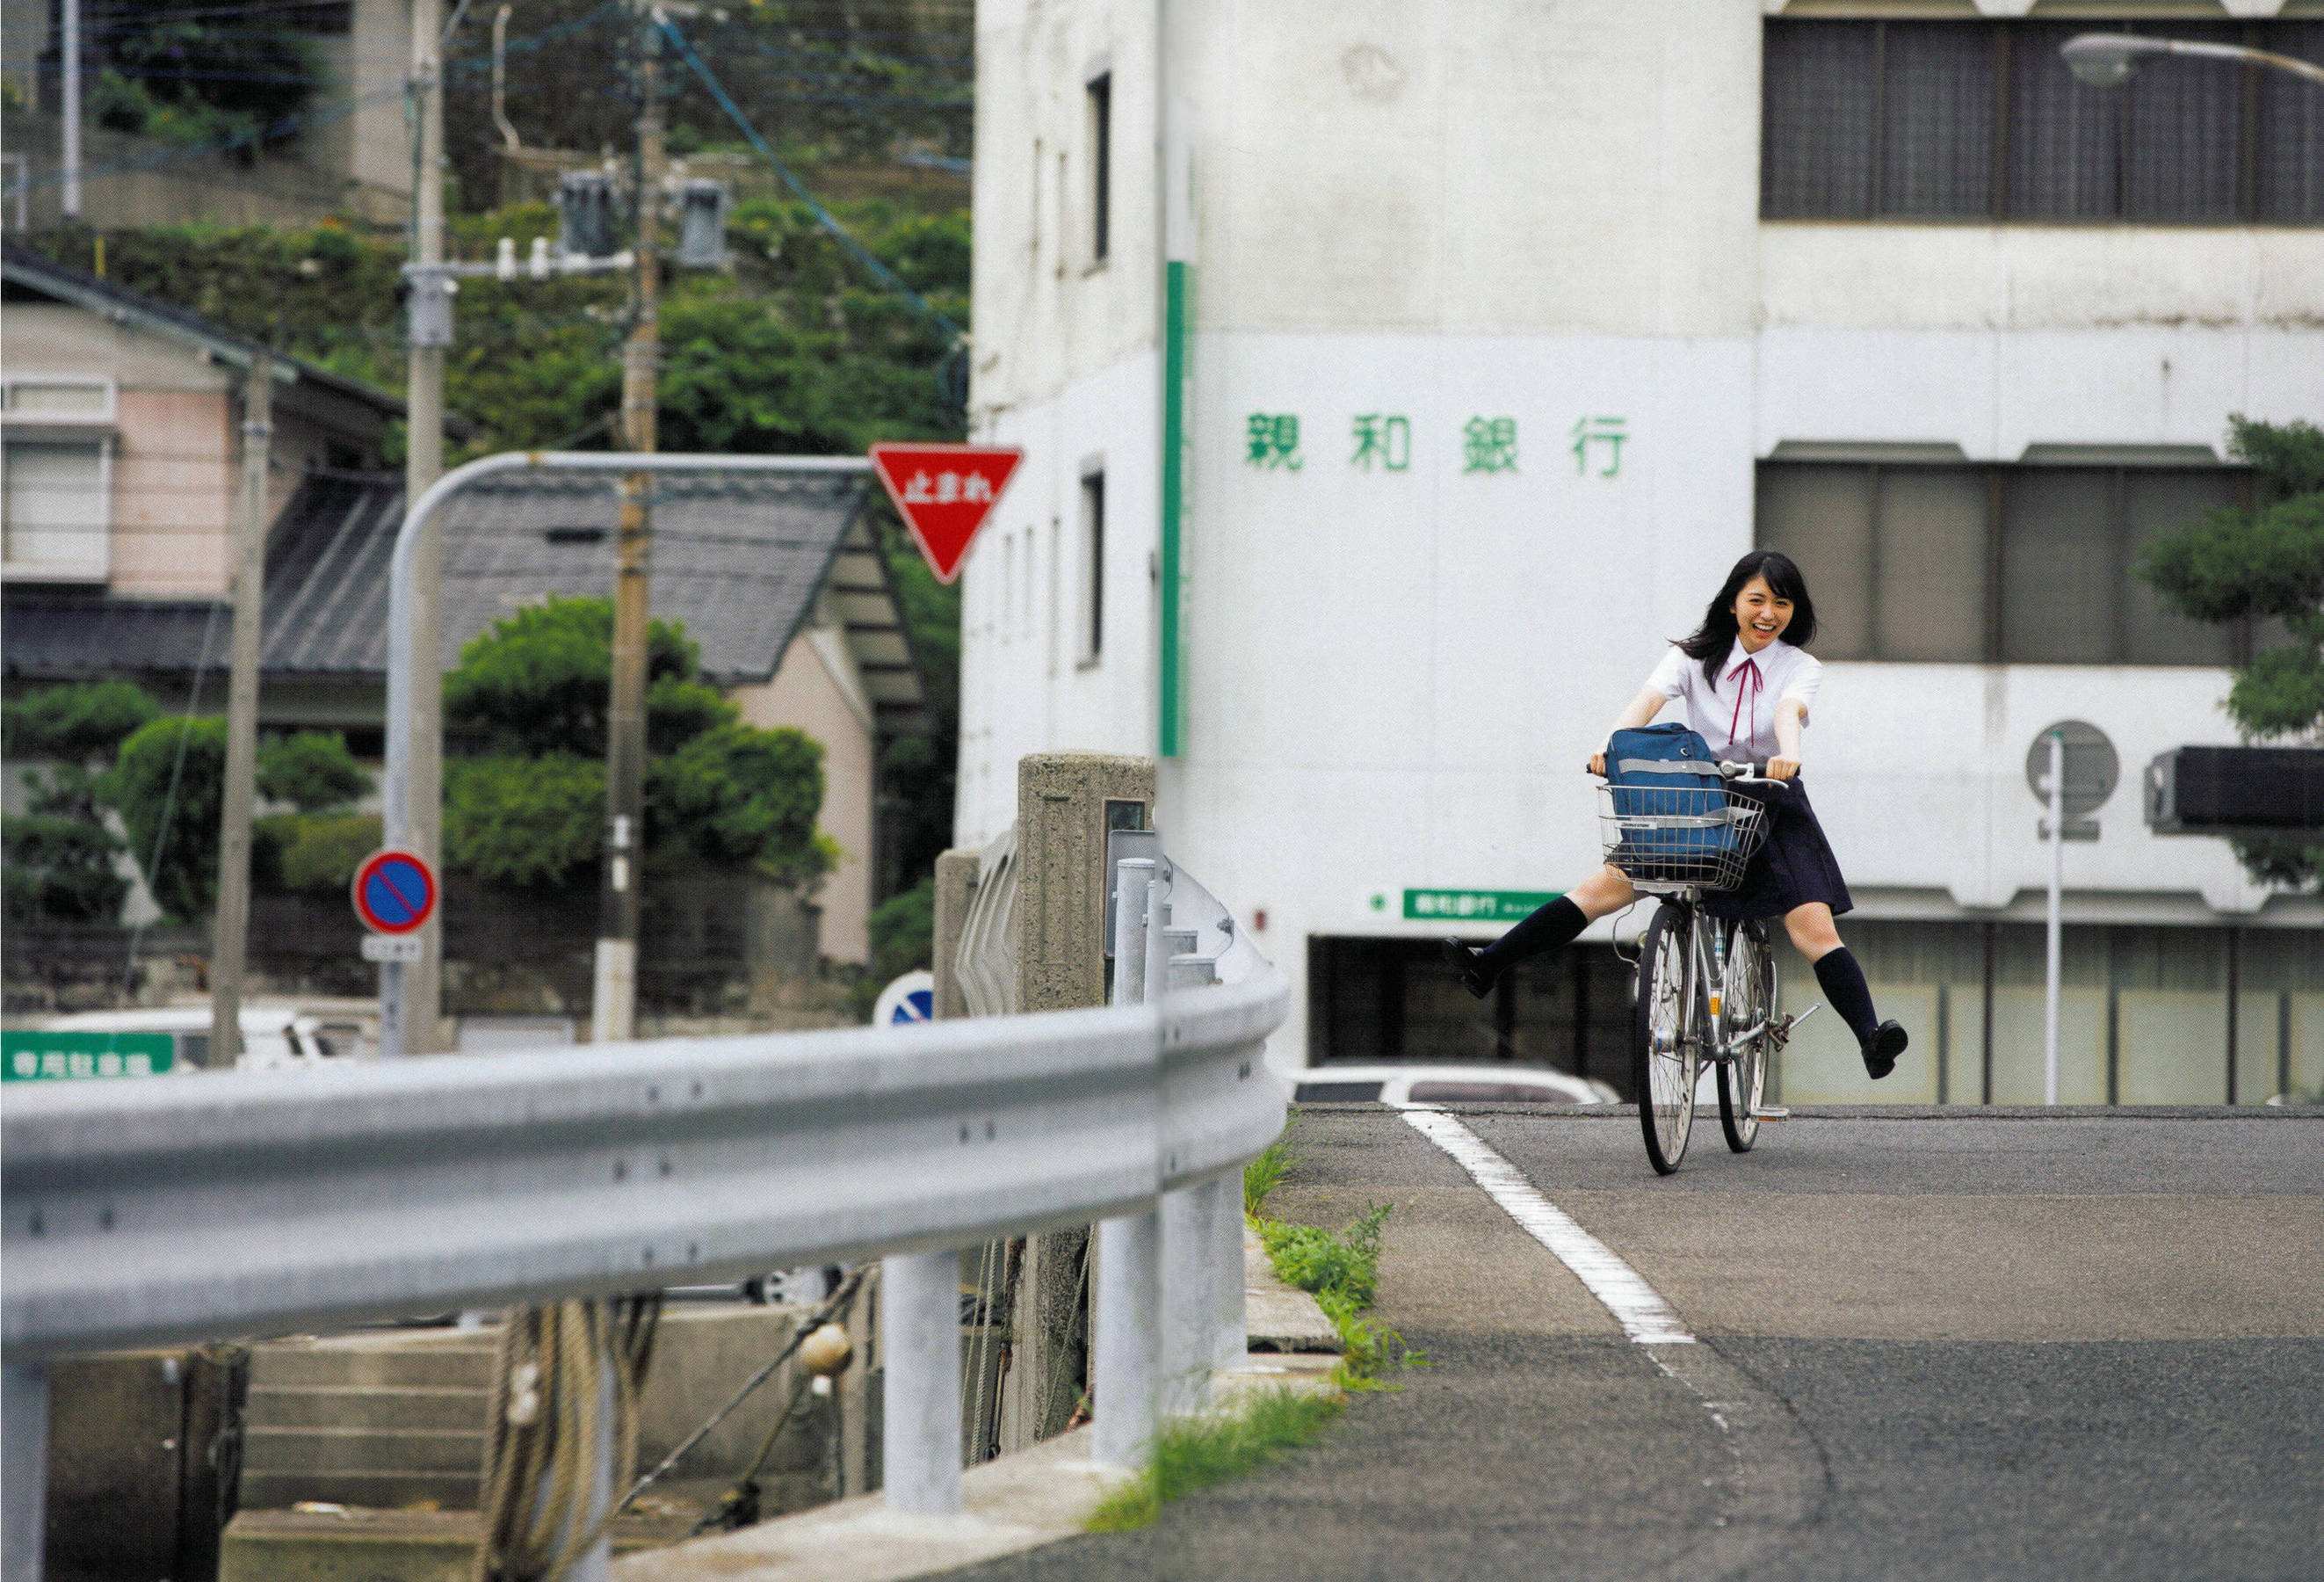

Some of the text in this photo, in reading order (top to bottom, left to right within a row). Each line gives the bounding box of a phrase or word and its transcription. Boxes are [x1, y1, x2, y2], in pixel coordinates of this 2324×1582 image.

[1244, 413, 1629, 476] 親和銀行
[905, 470, 991, 504] 止まれ
